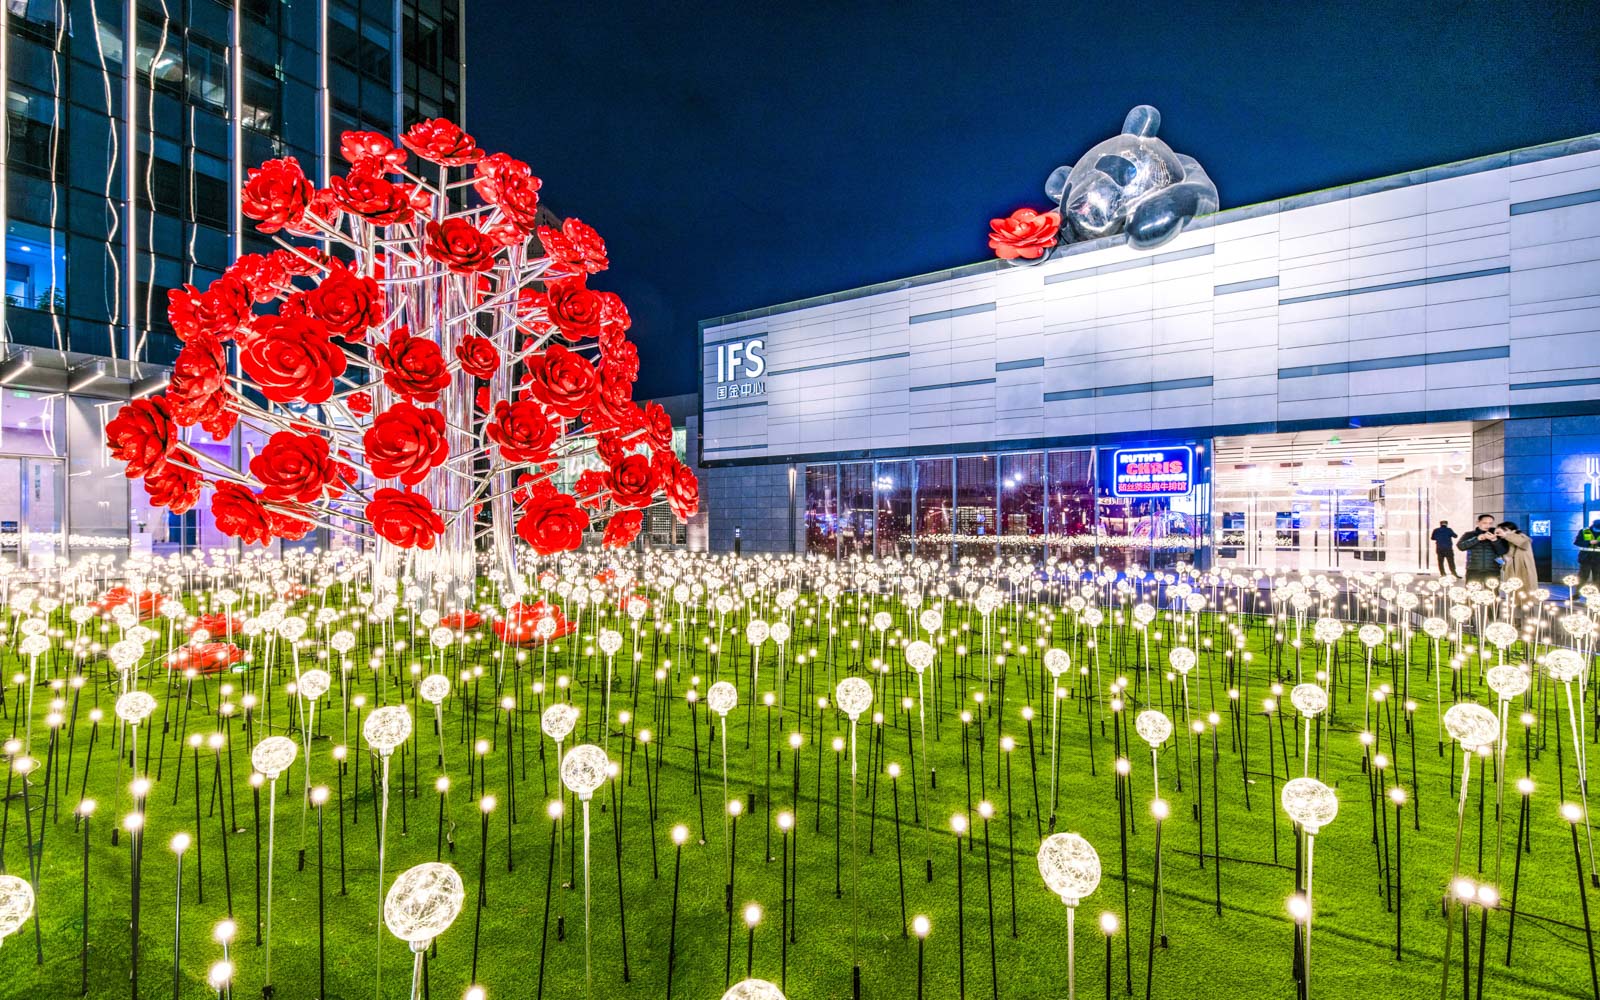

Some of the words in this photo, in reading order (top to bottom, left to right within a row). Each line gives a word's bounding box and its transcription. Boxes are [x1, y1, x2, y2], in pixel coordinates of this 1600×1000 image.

[718, 340, 764, 383] IFS
[717, 381, 766, 400] 国金中心
[1120, 453, 1163, 463] RUTH'S
[1126, 461, 1183, 474] CHRIS
